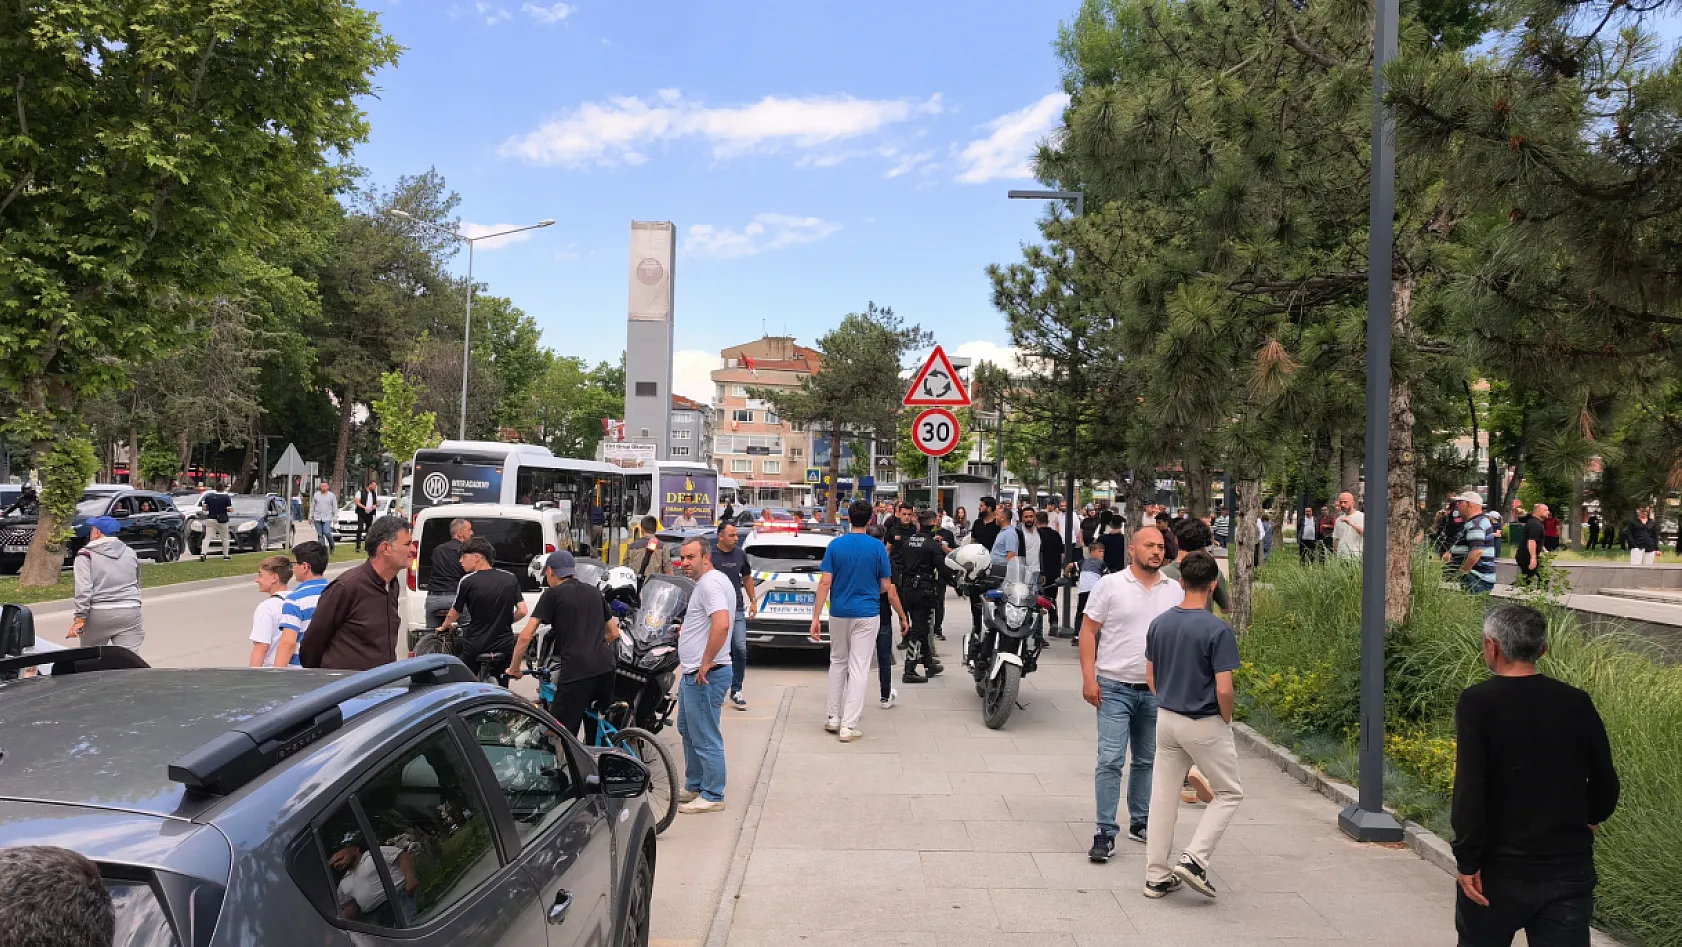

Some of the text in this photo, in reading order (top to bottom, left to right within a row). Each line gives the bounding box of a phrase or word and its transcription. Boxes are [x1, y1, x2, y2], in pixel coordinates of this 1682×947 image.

[922, 422, 950, 442] 30
[451, 479, 490, 489] INTER ACADEMY
